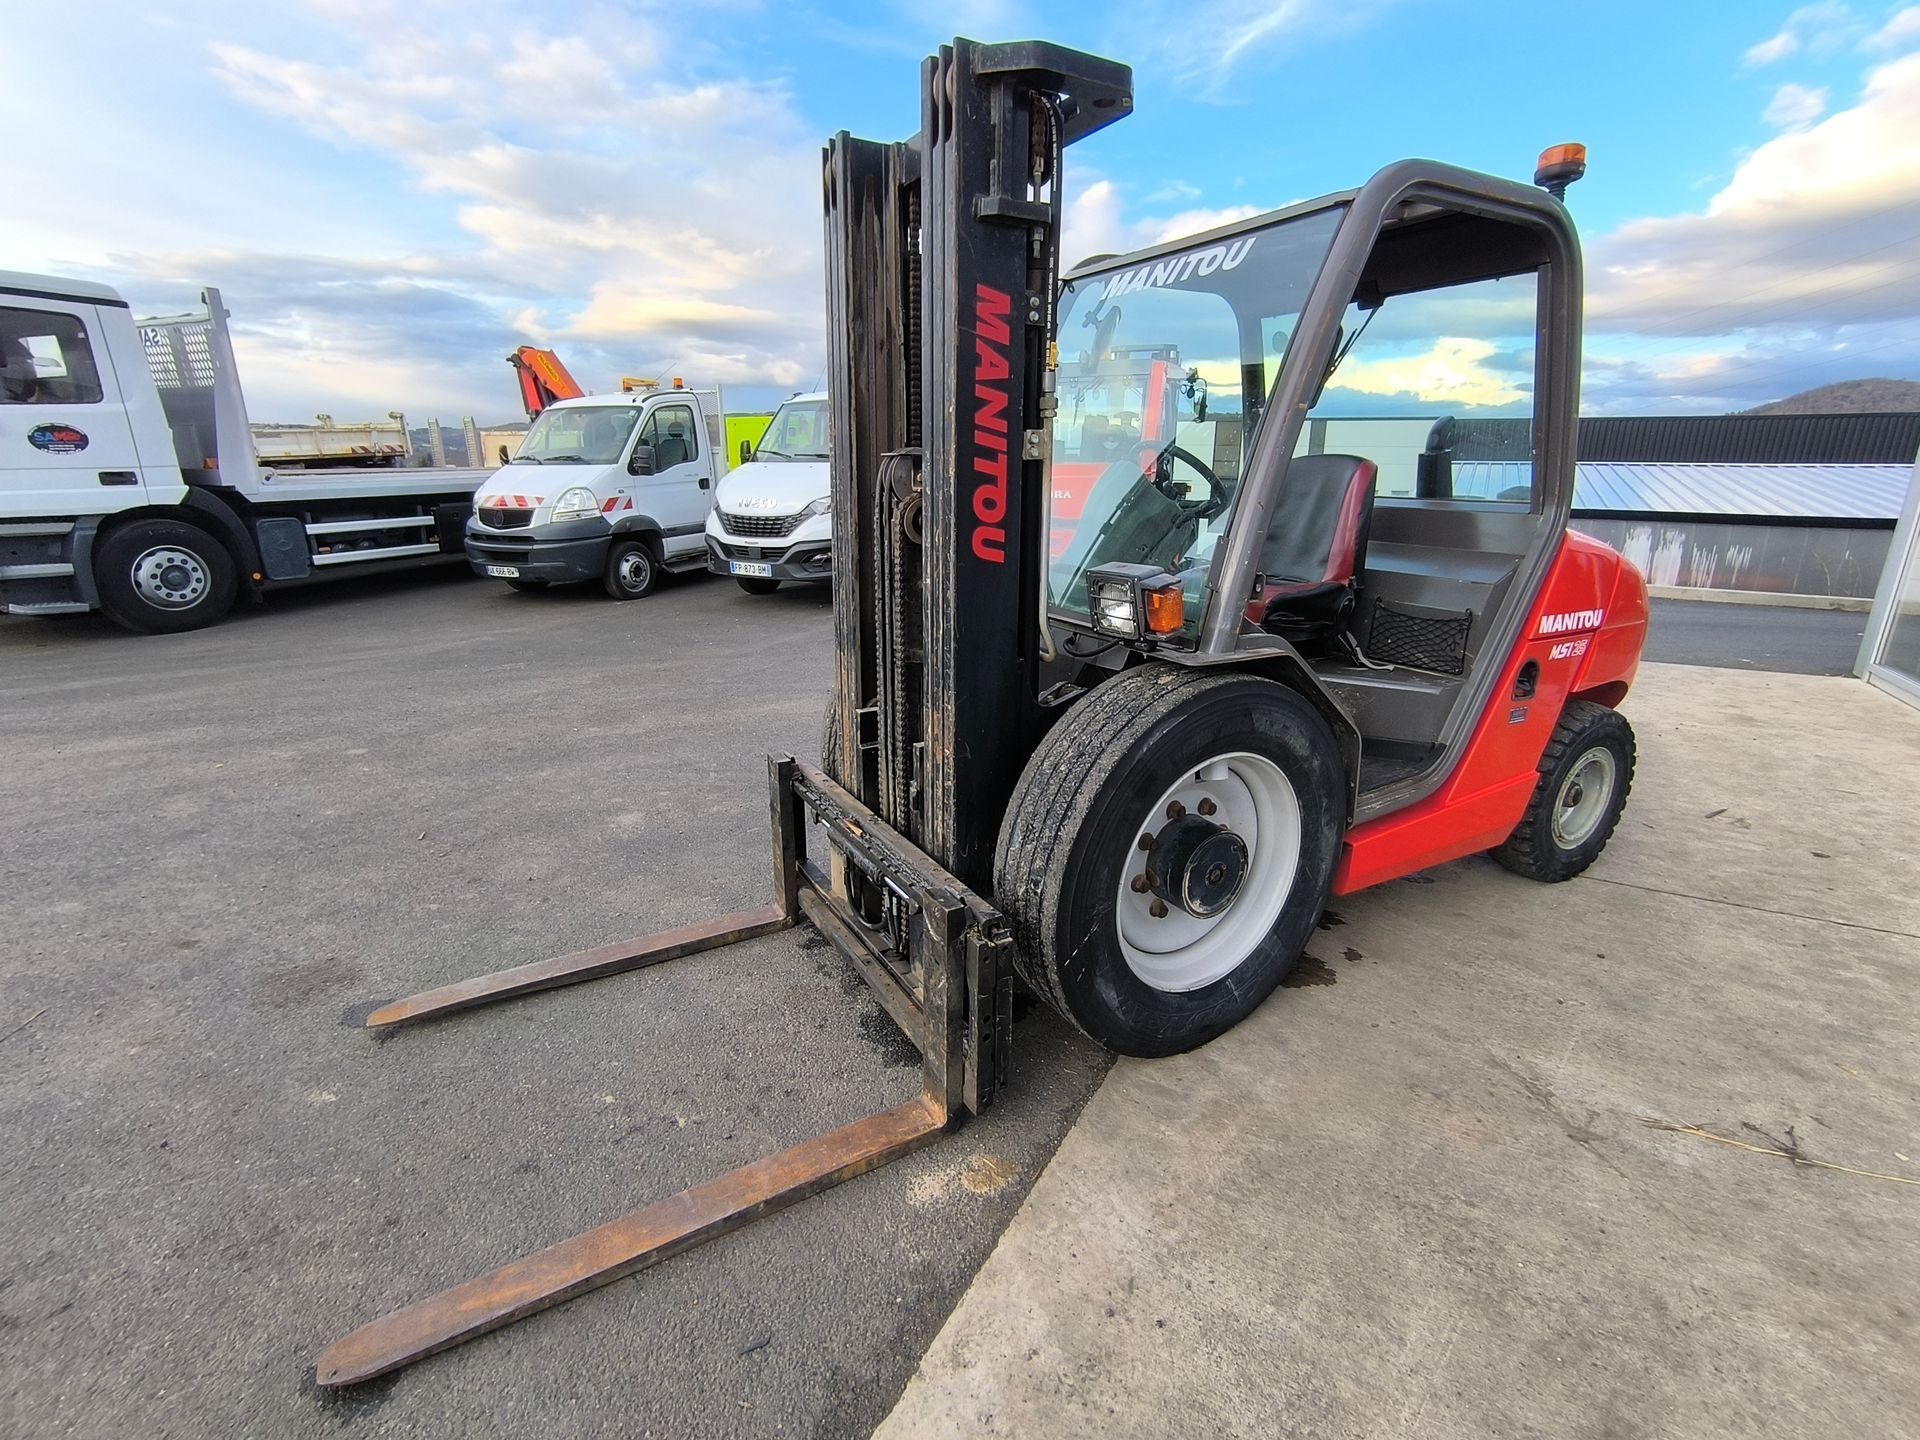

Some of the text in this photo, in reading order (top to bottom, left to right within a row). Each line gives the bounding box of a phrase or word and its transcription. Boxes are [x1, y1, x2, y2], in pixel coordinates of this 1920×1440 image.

[1100, 237, 1256, 300] MANITOU
[972, 283, 1011, 563] MANITOU
[738, 497, 777, 508] IVECO
[1539, 609, 1603, 634] MANITOU
